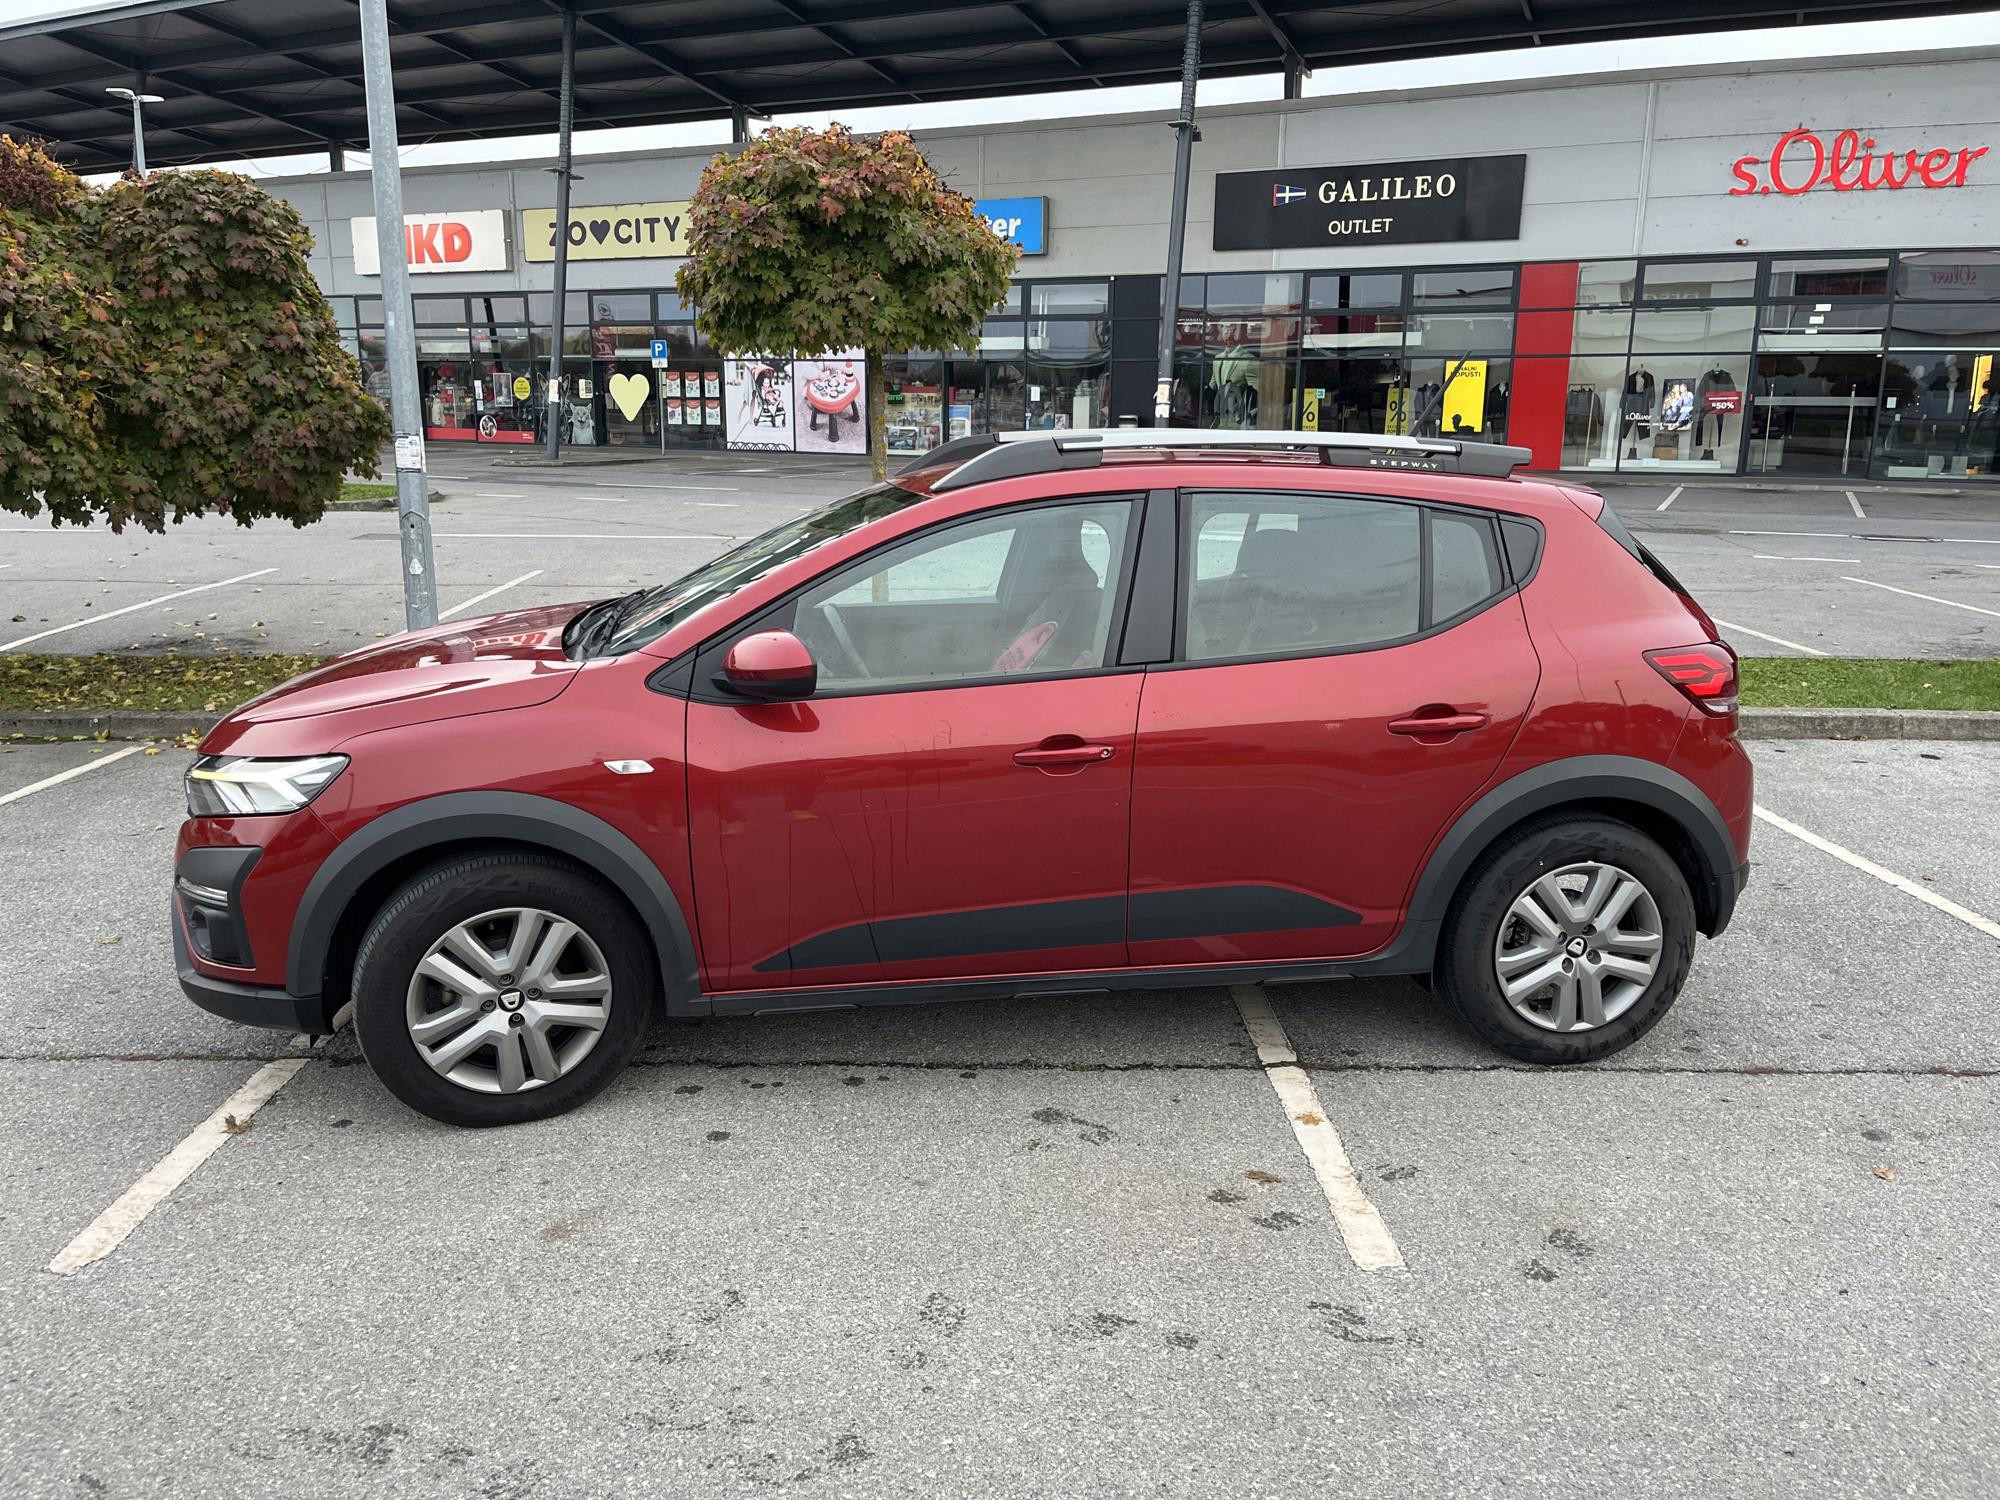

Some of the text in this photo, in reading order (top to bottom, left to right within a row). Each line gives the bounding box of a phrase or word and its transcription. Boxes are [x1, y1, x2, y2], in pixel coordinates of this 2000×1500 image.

[1729, 128, 1989, 195] s.Oliver
[1318, 174, 1456, 204] GALILEO
[1328, 218, 1393, 235] OUTLET
[655, 343, 663, 356] P
[1370, 460, 1438, 469] STEPWAY
